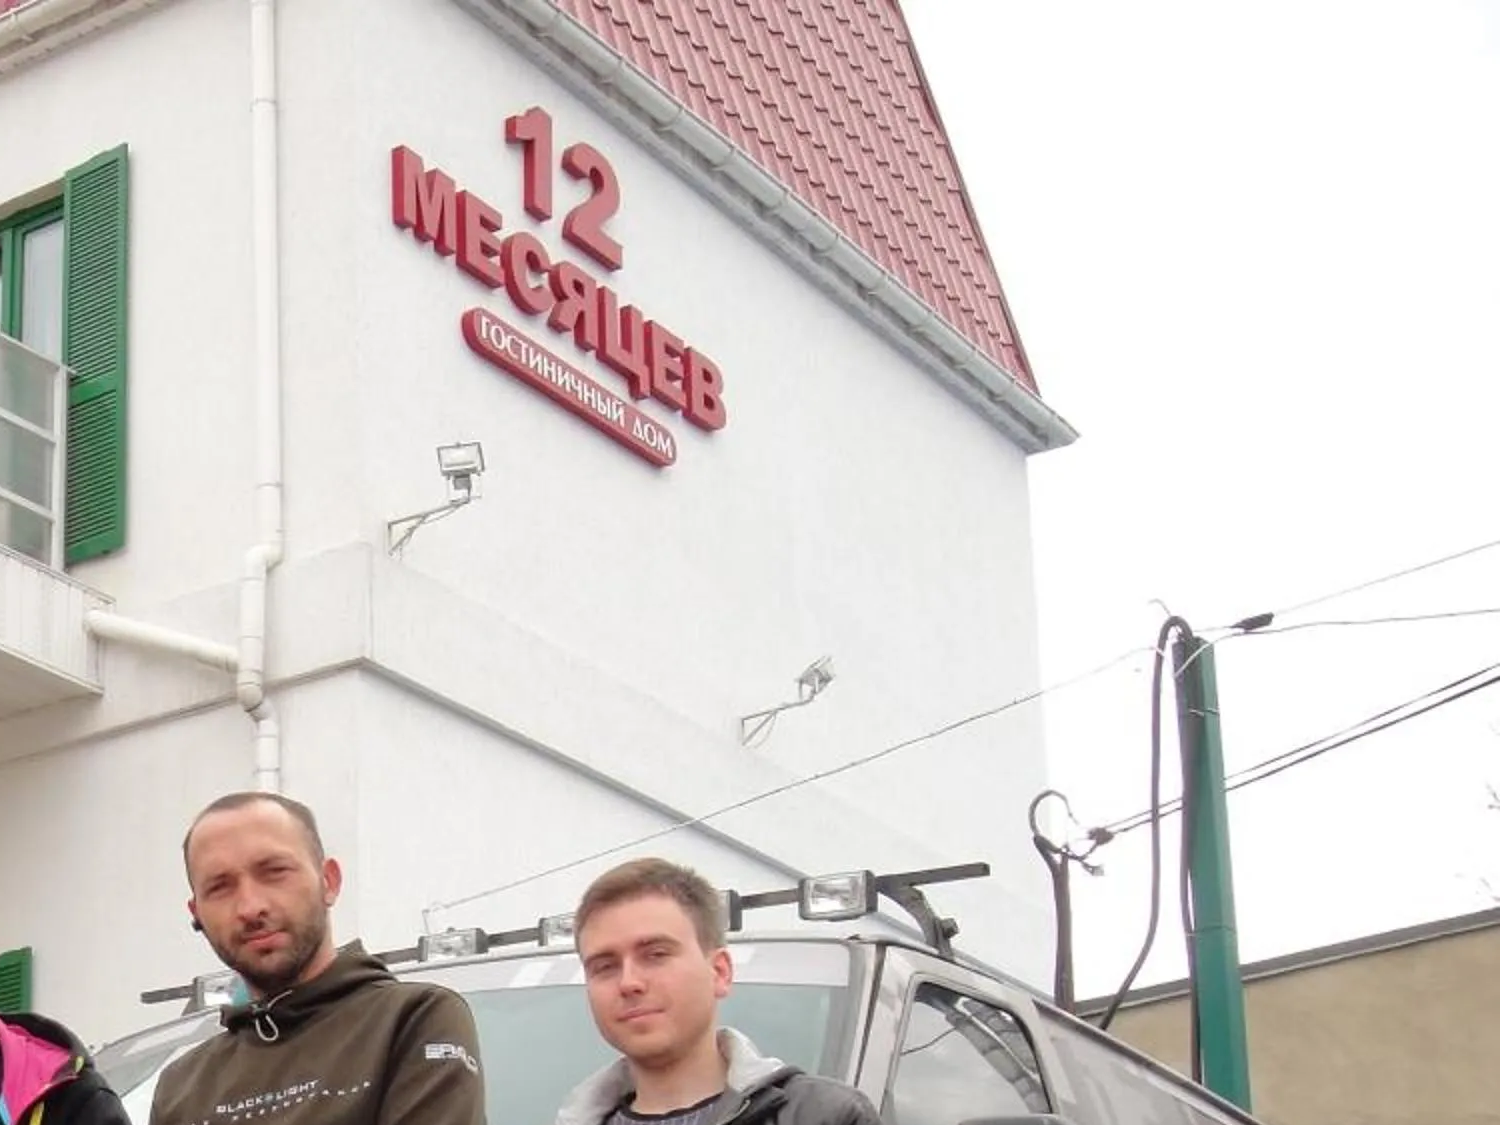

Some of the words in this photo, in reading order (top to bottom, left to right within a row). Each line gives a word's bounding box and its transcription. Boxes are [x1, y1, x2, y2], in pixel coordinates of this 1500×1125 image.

[505, 106, 623, 271] 12
[391, 144, 726, 432] МЕСЯЦЕВ
[479, 316, 625, 428] ГОСТИНИЧНЫЙ
[632, 417, 673, 460] ДОМ
